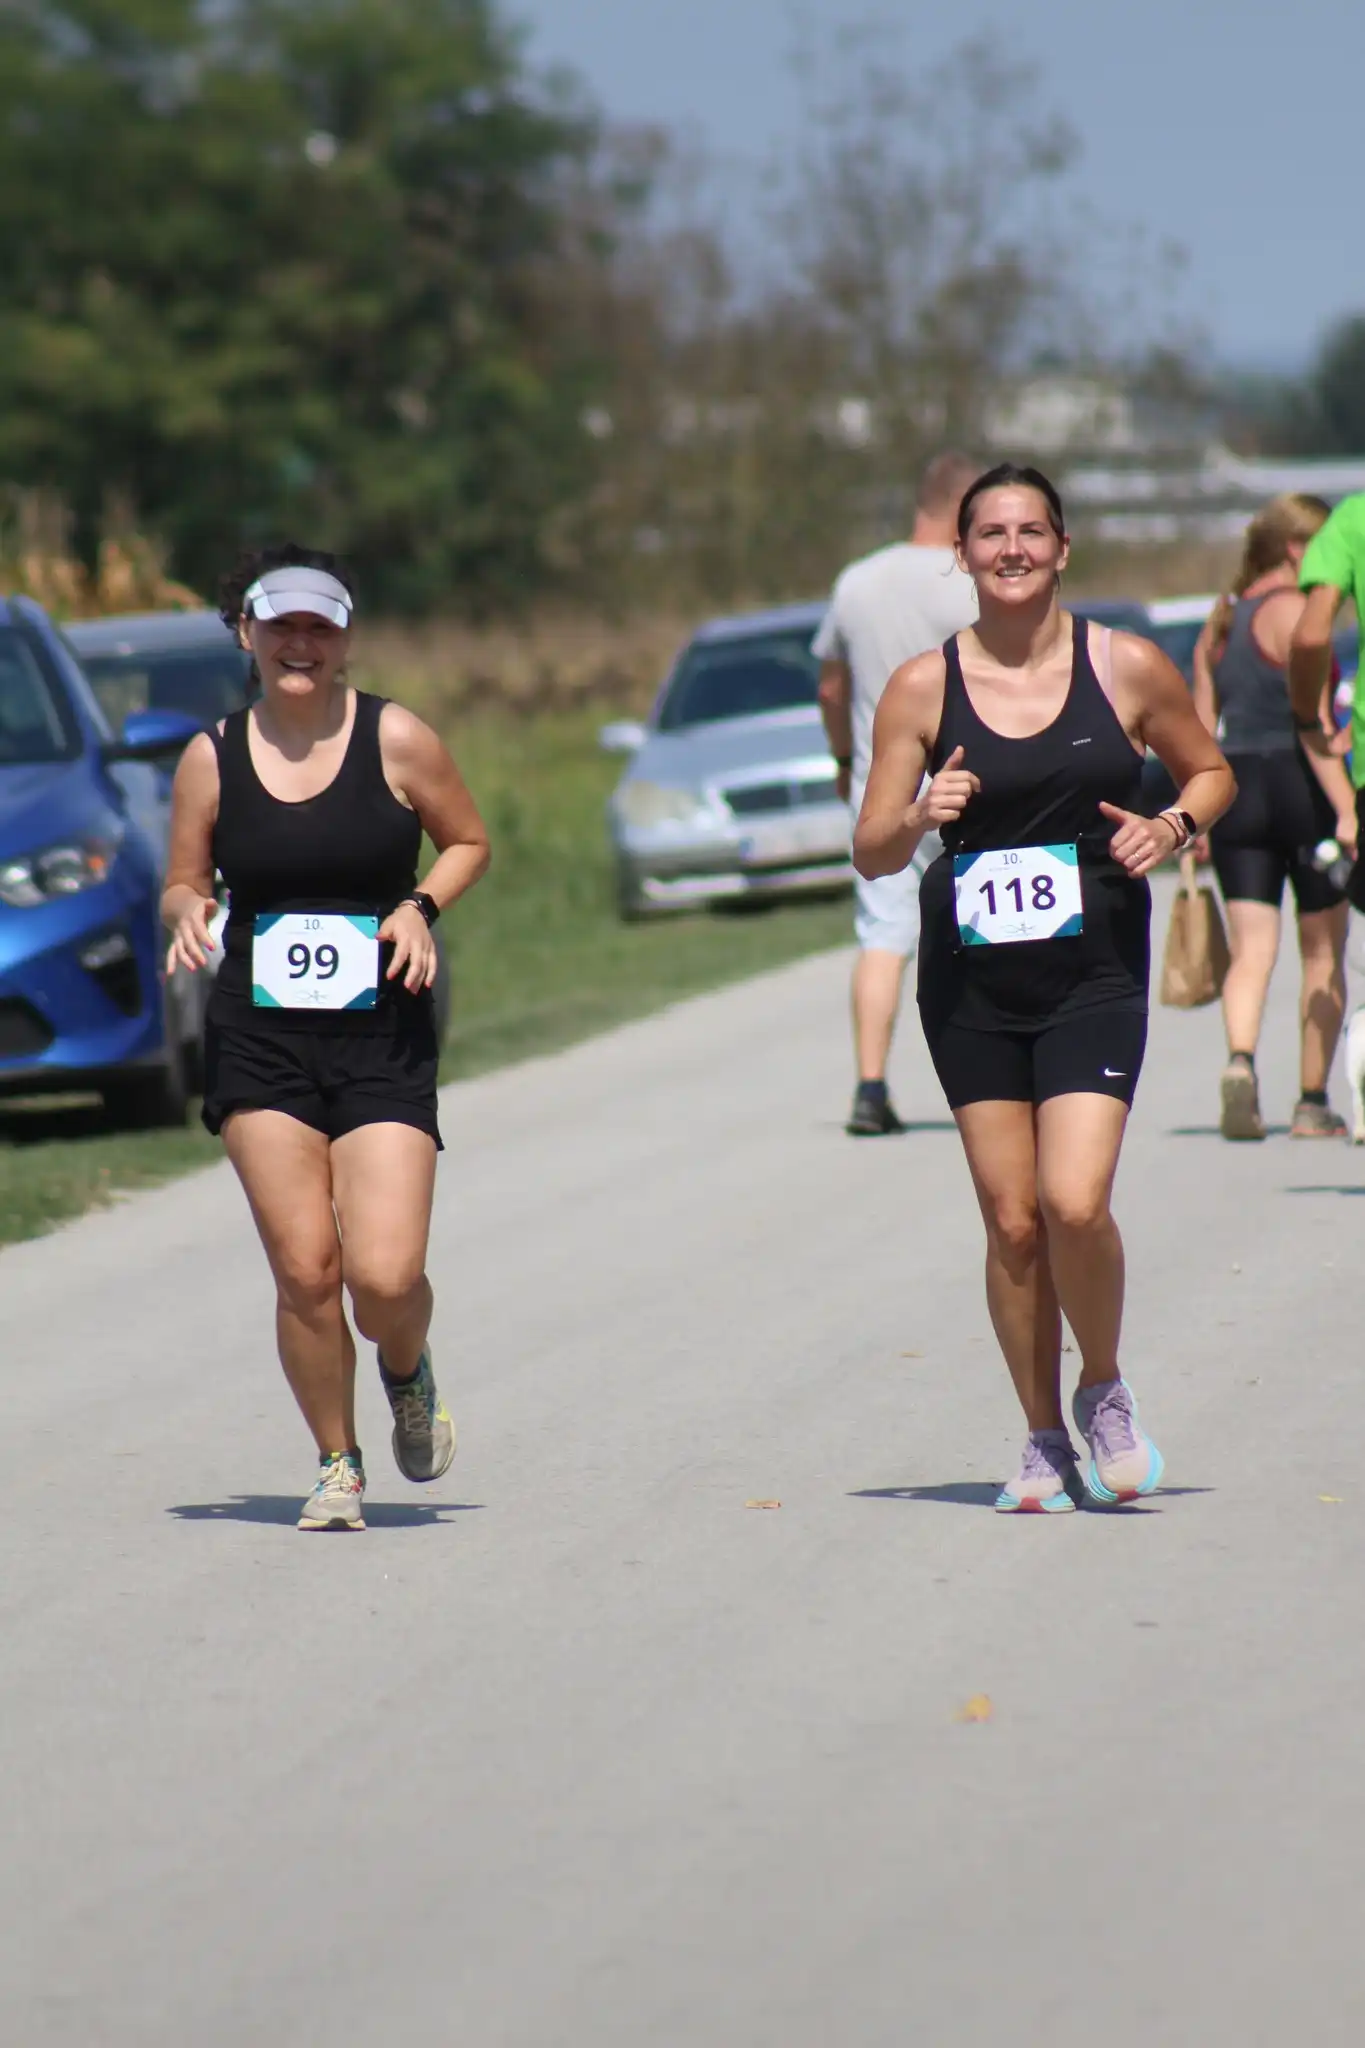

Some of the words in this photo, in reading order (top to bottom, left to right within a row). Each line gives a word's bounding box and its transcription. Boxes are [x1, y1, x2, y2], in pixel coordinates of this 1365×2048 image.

[1003, 853, 1023, 865] 10.
[979, 874, 1056, 915] 118
[303, 918, 324, 930] 10.
[288, 943, 339, 979] 99
